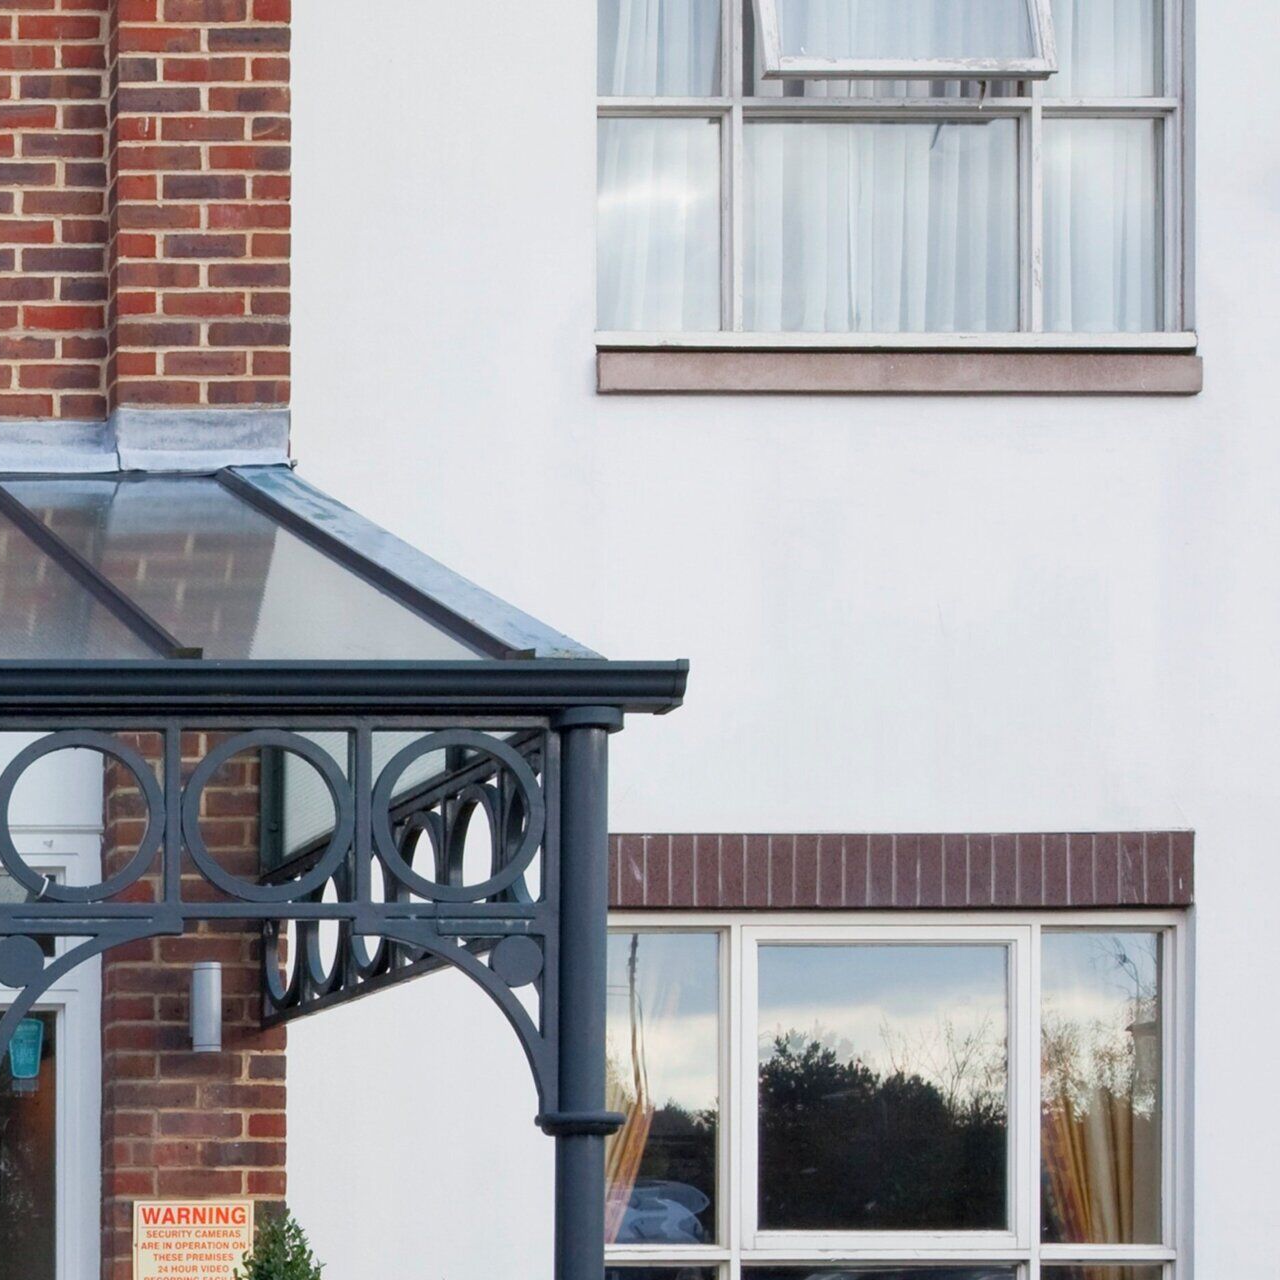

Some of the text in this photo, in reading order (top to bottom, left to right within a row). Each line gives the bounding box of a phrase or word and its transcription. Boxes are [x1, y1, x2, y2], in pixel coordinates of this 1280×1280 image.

[141, 1207, 246, 1224] WARNING
[146, 1230, 241, 1238] SECURITY CAMERAS
[141, 1242, 246, 1250] ARE IN OPERATION ON
[158, 1265, 229, 1273] 24 HOUR VIDEO
